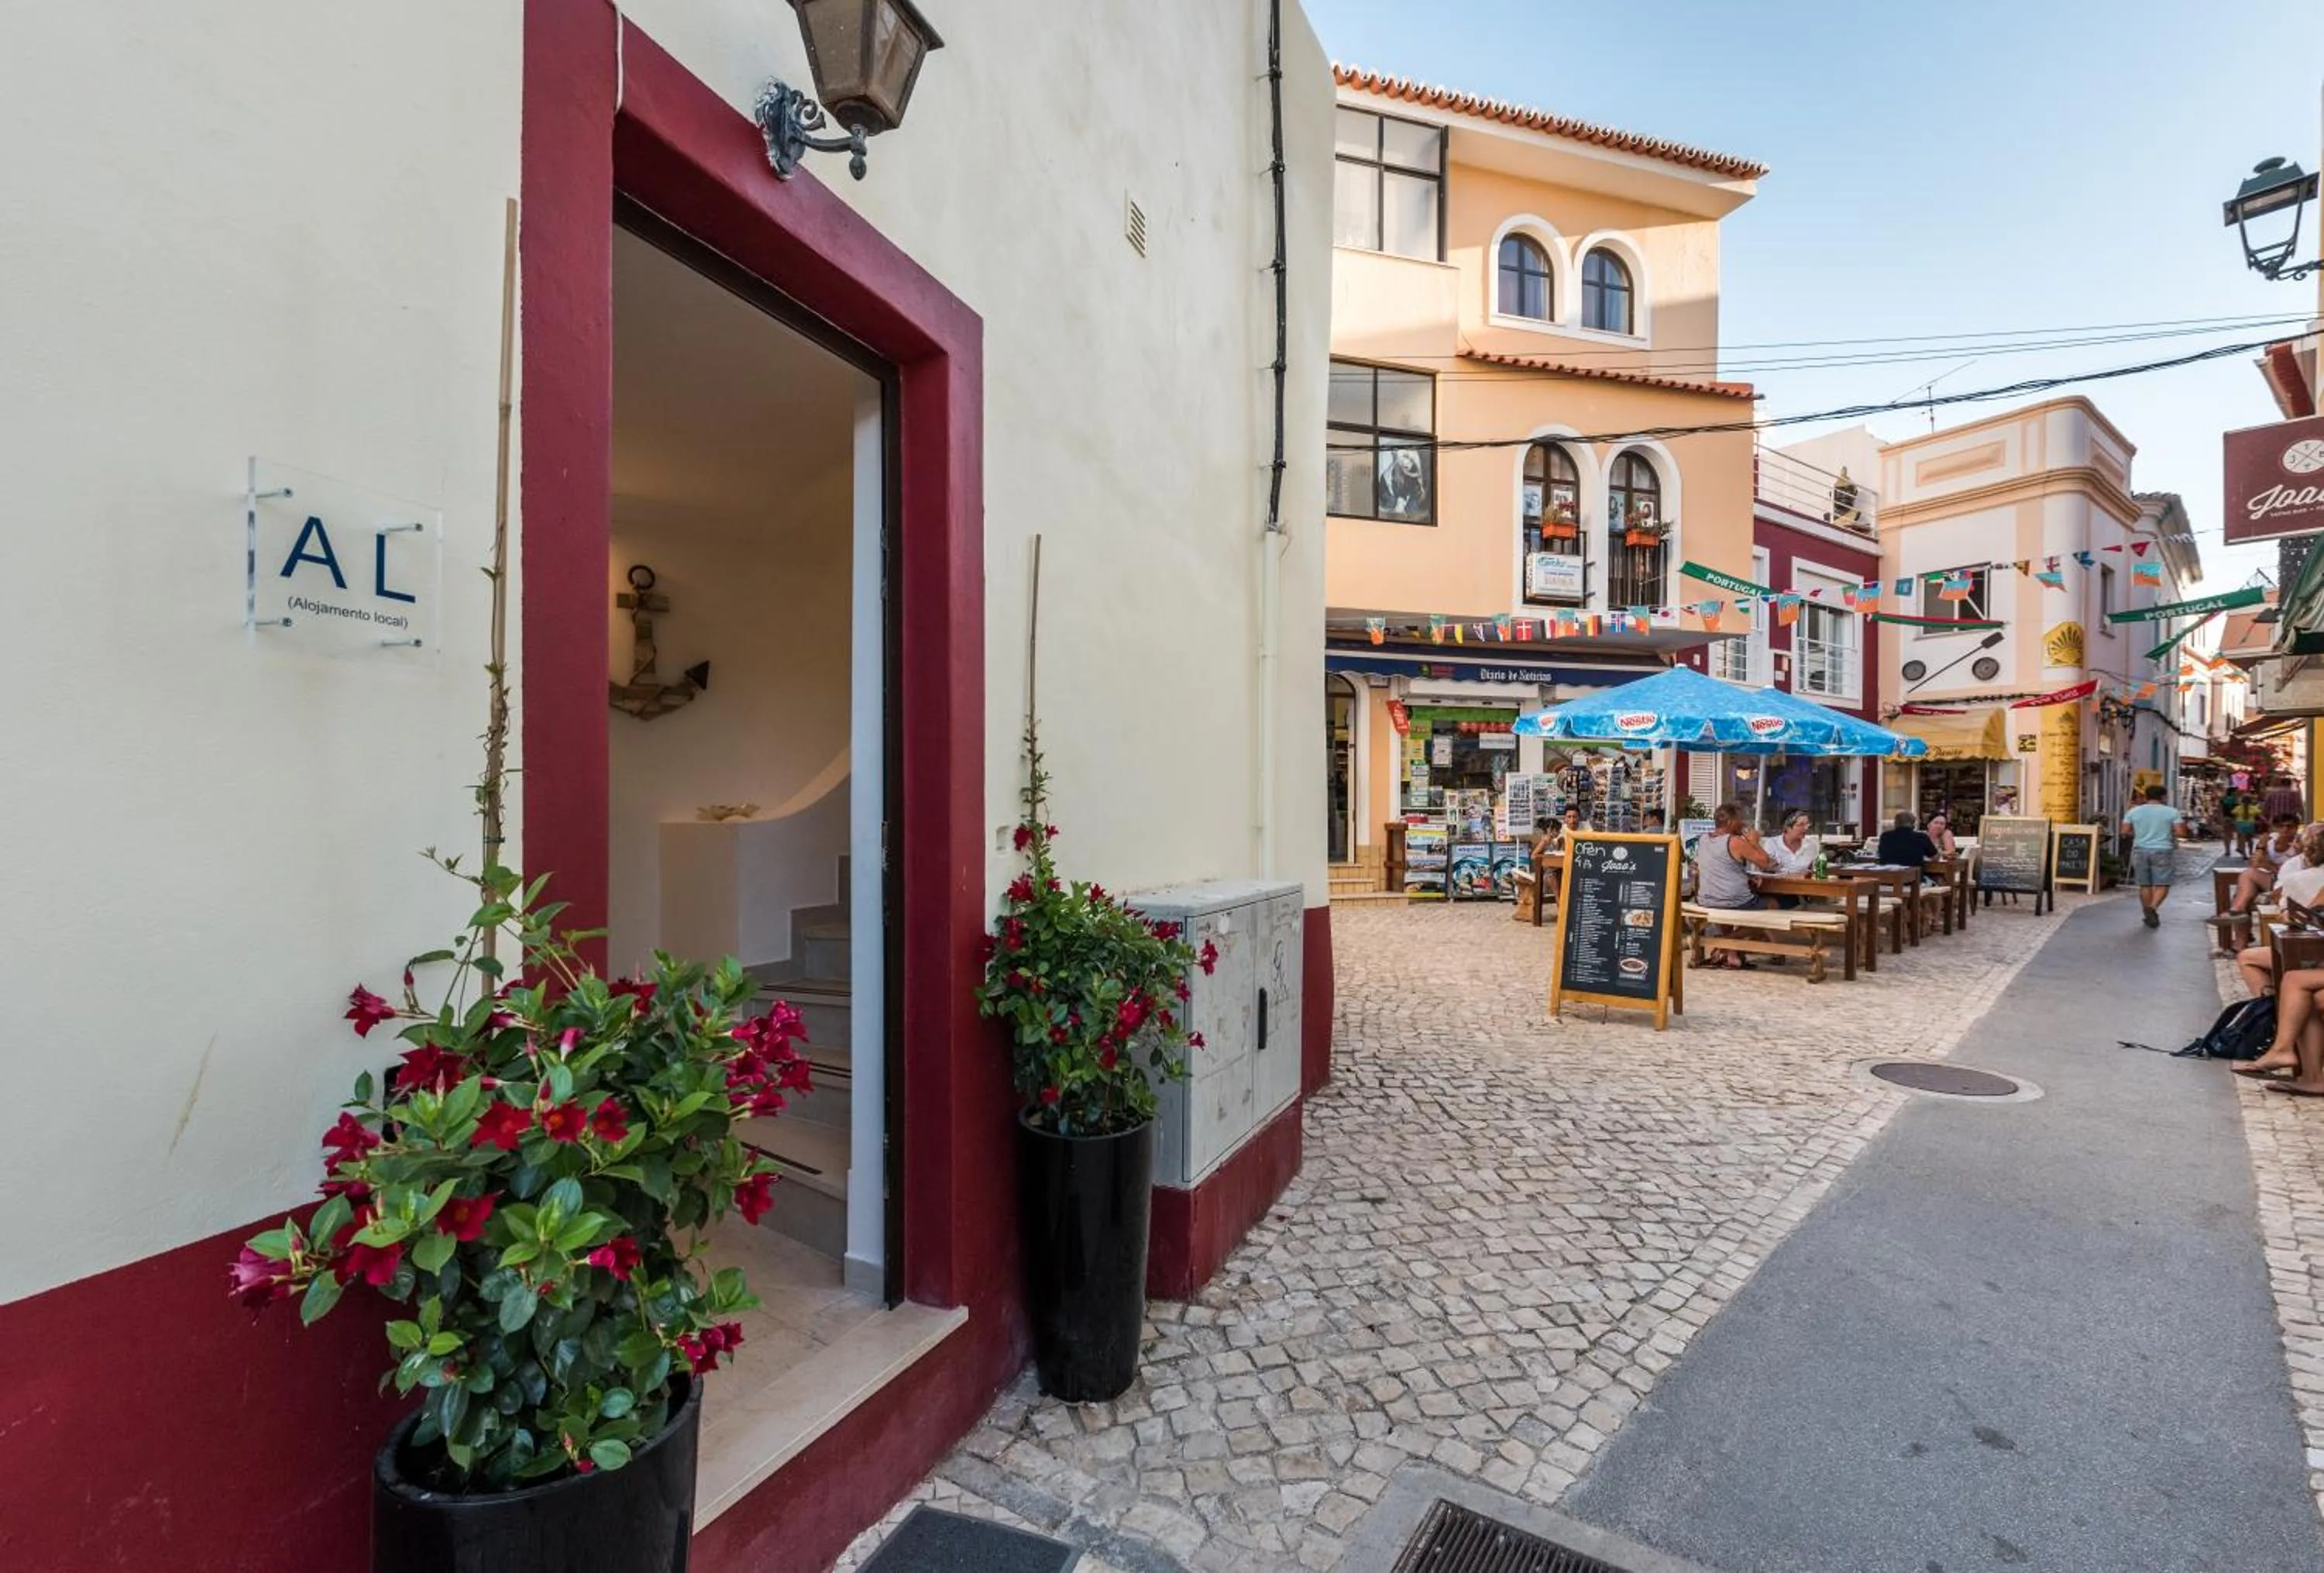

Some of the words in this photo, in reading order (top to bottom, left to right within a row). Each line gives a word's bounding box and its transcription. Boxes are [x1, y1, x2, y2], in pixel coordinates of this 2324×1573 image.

[2247, 484, 2324, 521] Joa
[279, 515, 348, 590] A
[375, 532, 416, 604] L
[1705, 572, 1763, 597] PORTUGAL
[287, 595, 372, 621] (Alojamento
[373, 611, 409, 630] local)
[2144, 599, 2228, 621] PORTUGAL
